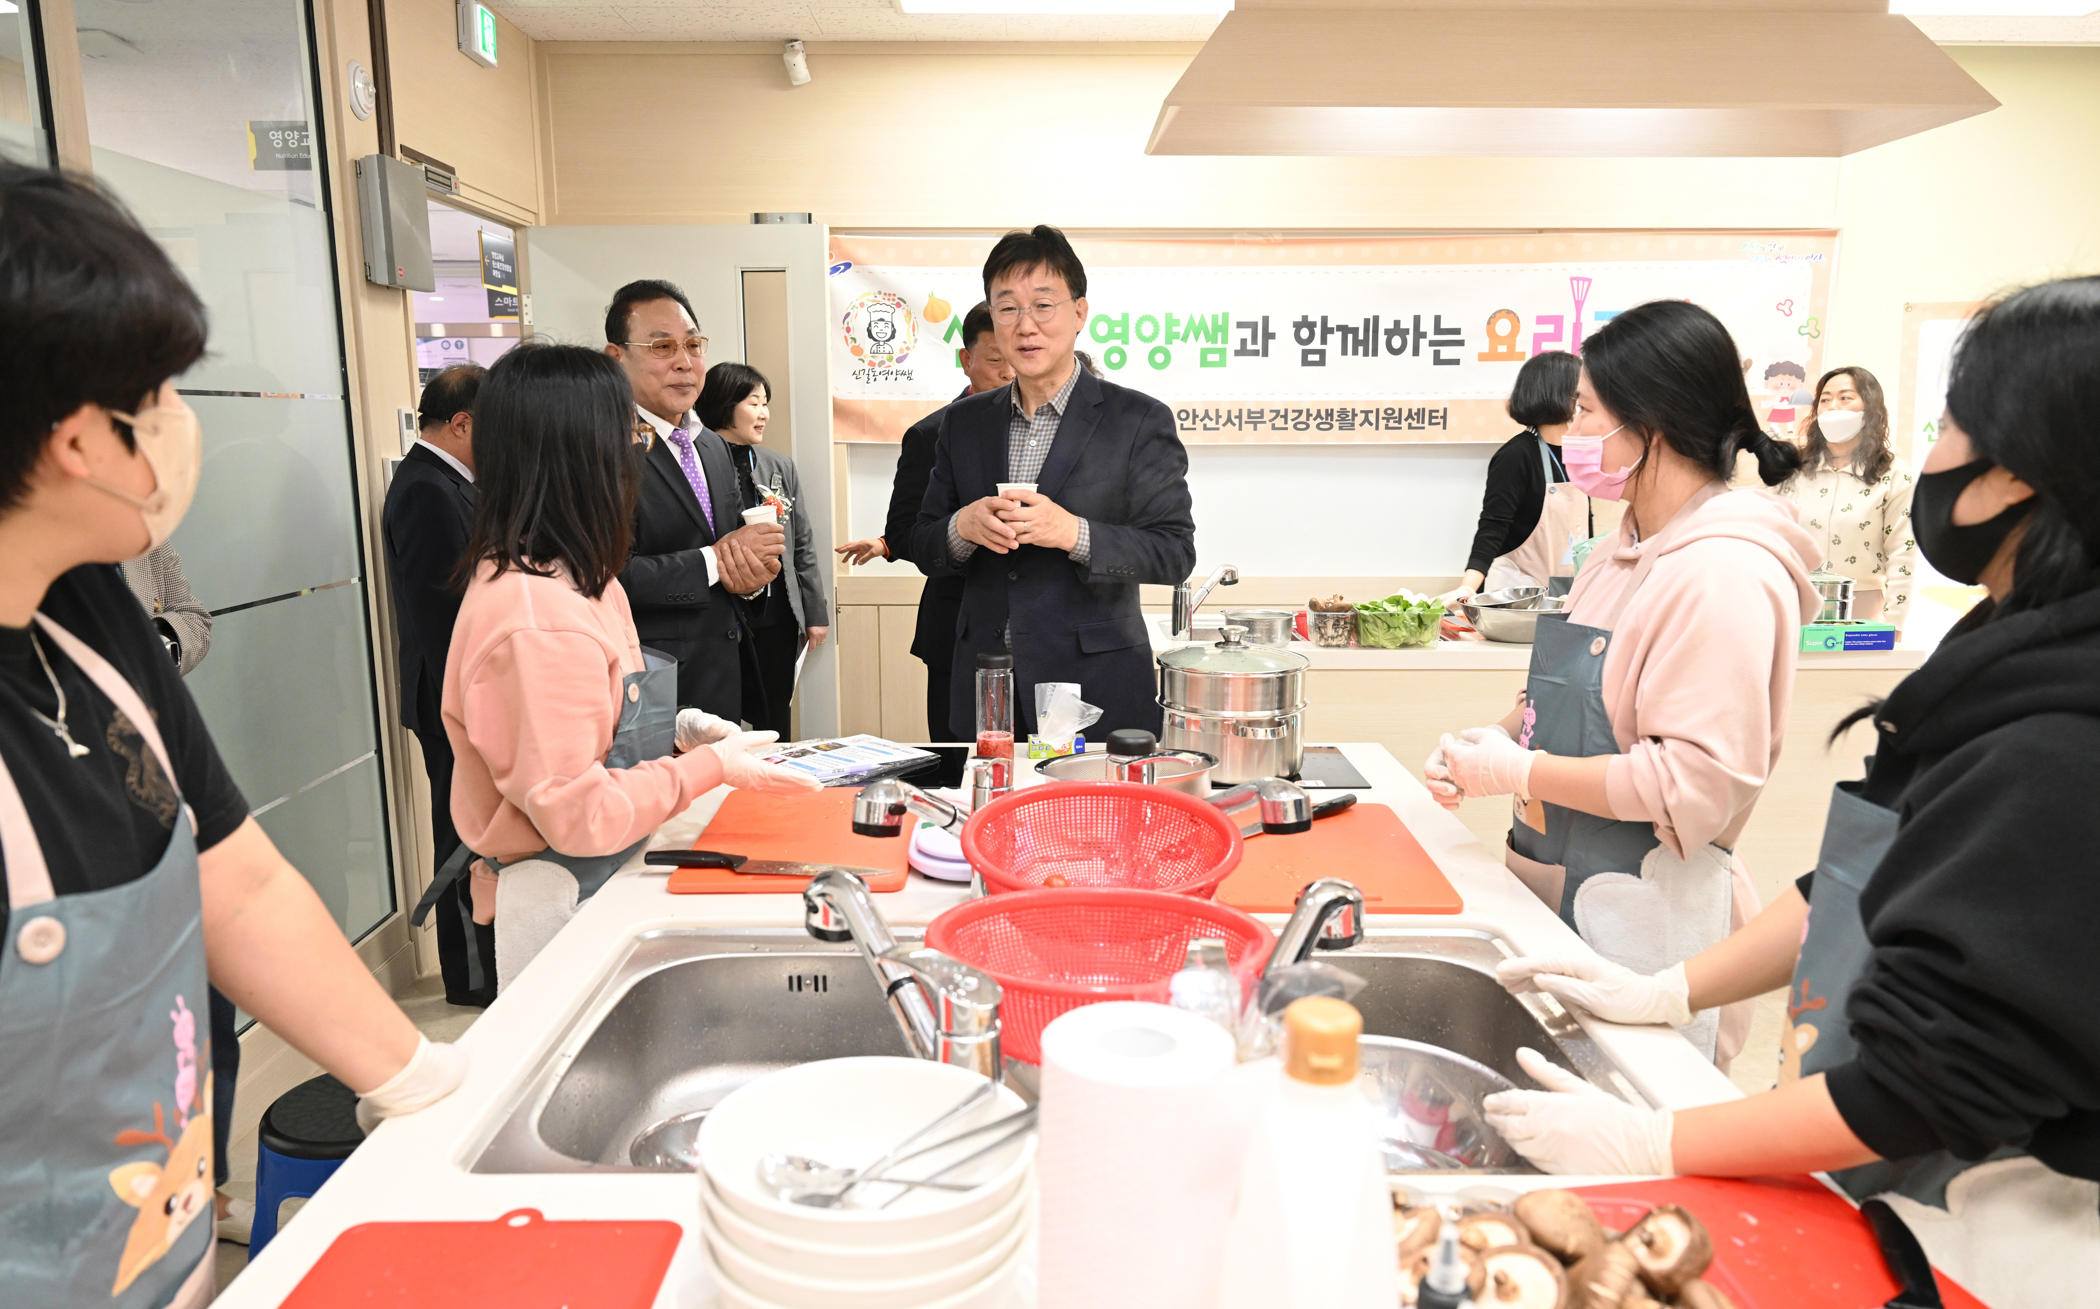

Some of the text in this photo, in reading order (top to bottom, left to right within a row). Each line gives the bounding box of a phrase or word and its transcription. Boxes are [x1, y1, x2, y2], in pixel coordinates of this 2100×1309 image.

[494, 296, 518, 307] 스마트
[1292, 314, 1465, 367] 함께하는
[852, 368, 914, 384] 신길동영양쌤
[1177, 407, 1448, 432] 안산서부건강생활지원센터
